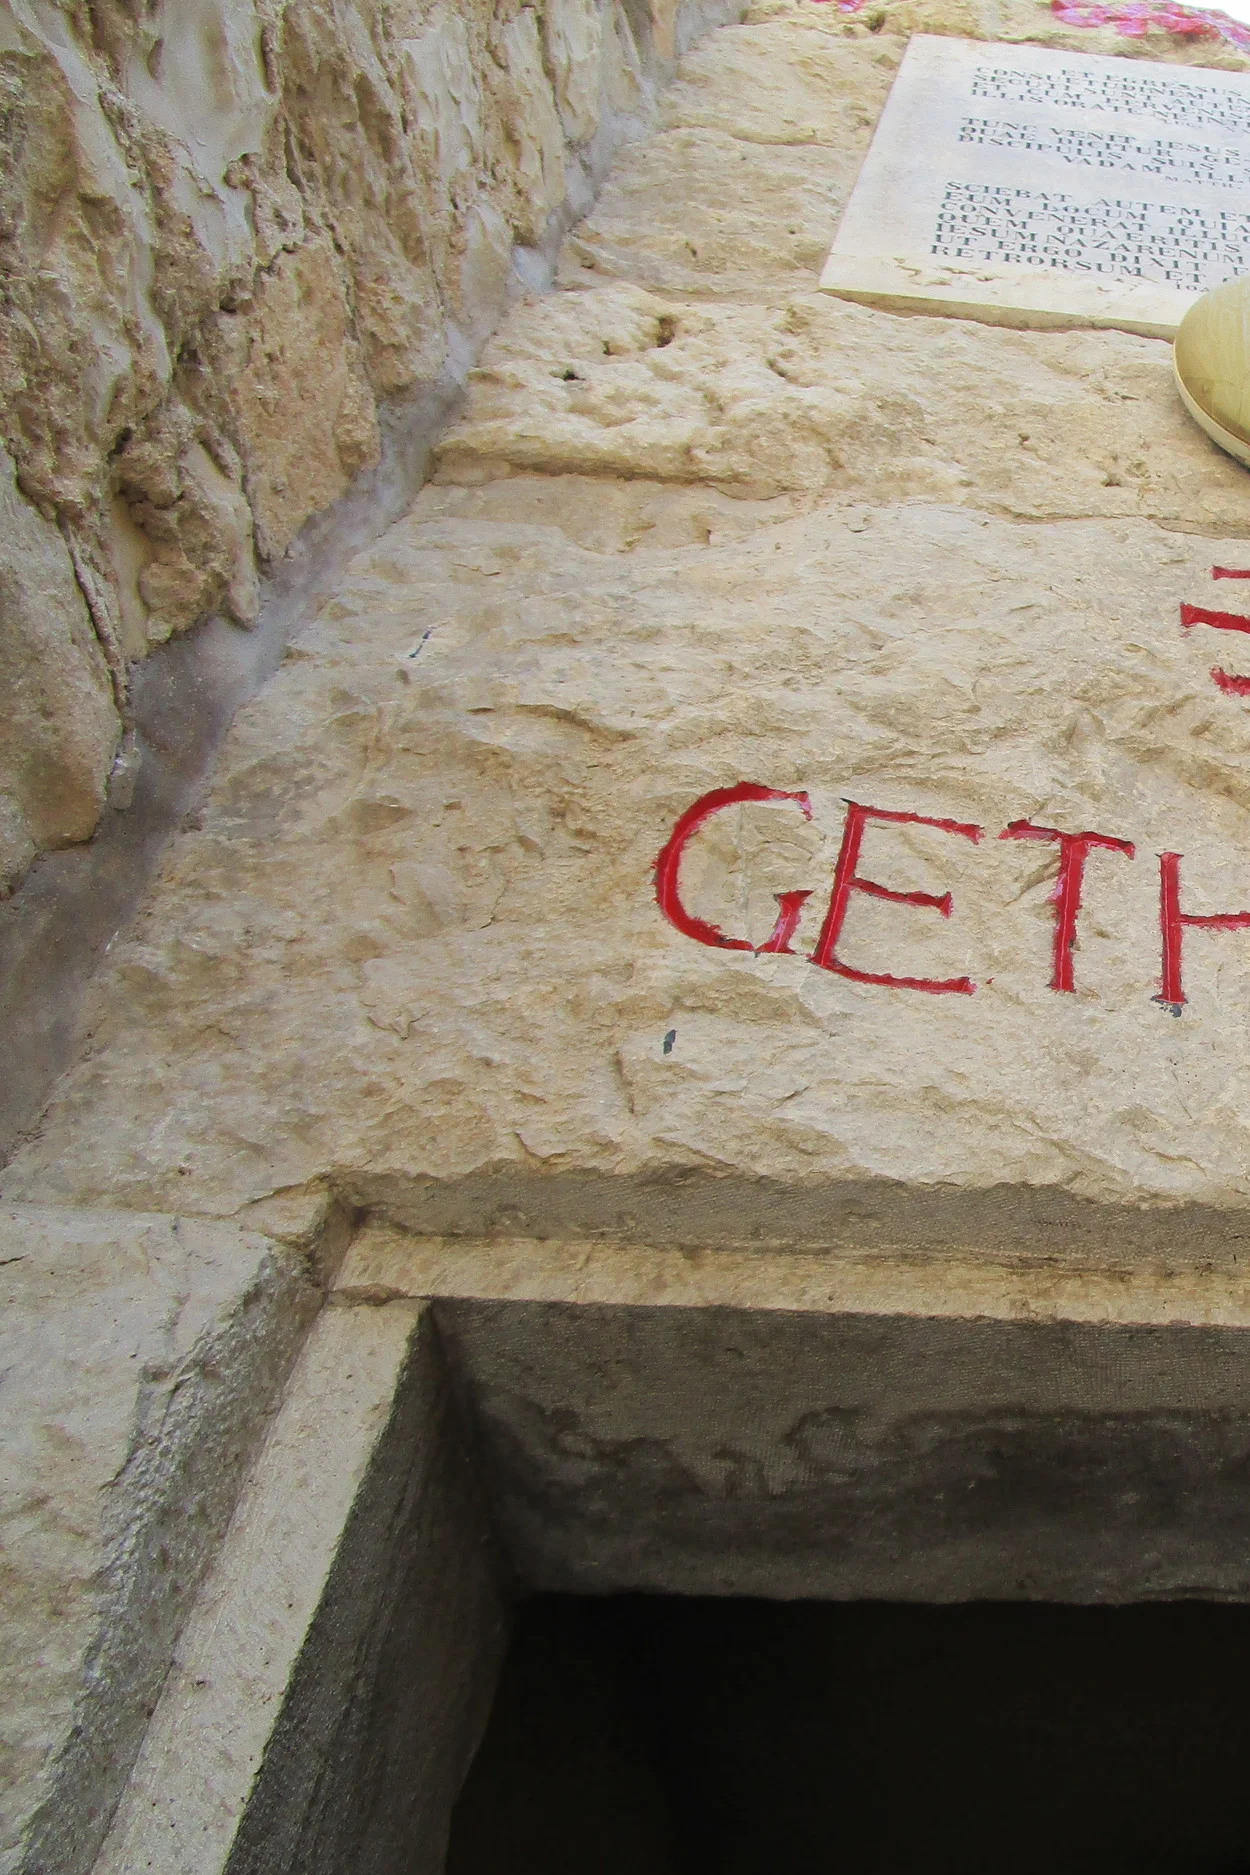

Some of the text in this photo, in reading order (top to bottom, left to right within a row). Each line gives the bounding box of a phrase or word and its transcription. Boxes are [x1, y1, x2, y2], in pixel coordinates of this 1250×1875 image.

[972, 74, 1069, 90] SECUTI
[1084, 87, 1155, 101] SUNT
[972, 81, 1005, 90] ET
[1026, 88, 1081, 99] CUM
[976, 67, 1203, 99] CONSUETUDINEM
[1226, 97, 1250, 105] IN
[1061, 69, 1093, 77] ET
[1105, 74, 1241, 96] EGRESSUS
[971, 89, 1042, 102] ILLIS
[1053, 99, 1141, 114] ORATE
[1152, 111, 1186, 120] NE
[958, 134, 1121, 159] DISCIPULIS
[1151, 157, 1214, 170] SUIS
[960, 126, 1035, 140] QUAE
[1058, 137, 1171, 156] DICITUR
[961, 117, 1036, 131] TUNC
[1049, 127, 1135, 143] VENIT
[1154, 140, 1239, 156] IESUS
[1062, 155, 1161, 173] VADAM
[940, 201, 1150, 231] CONVENERAT
[943, 191, 1011, 205] EUM
[1042, 202, 1145, 220] LOCUM
[1177, 218, 1250, 233] QUIA
[945, 181, 1072, 202] SCIEBAT
[1095, 197, 1200, 216] AUTEM
[936, 222, 1037, 241] IESUM
[1046, 234, 1243, 264] NAZARENUM
[937, 213, 1027, 229] QUEM
[1056, 225, 1239, 252] QUAERITIS
[929, 244, 1144, 278] RETRORSUM
[1164, 271, 1205, 283] ET
[935, 234, 977, 245] UT
[997, 240, 1081, 256] ERGO
[1109, 253, 1205, 271] DIXIT
